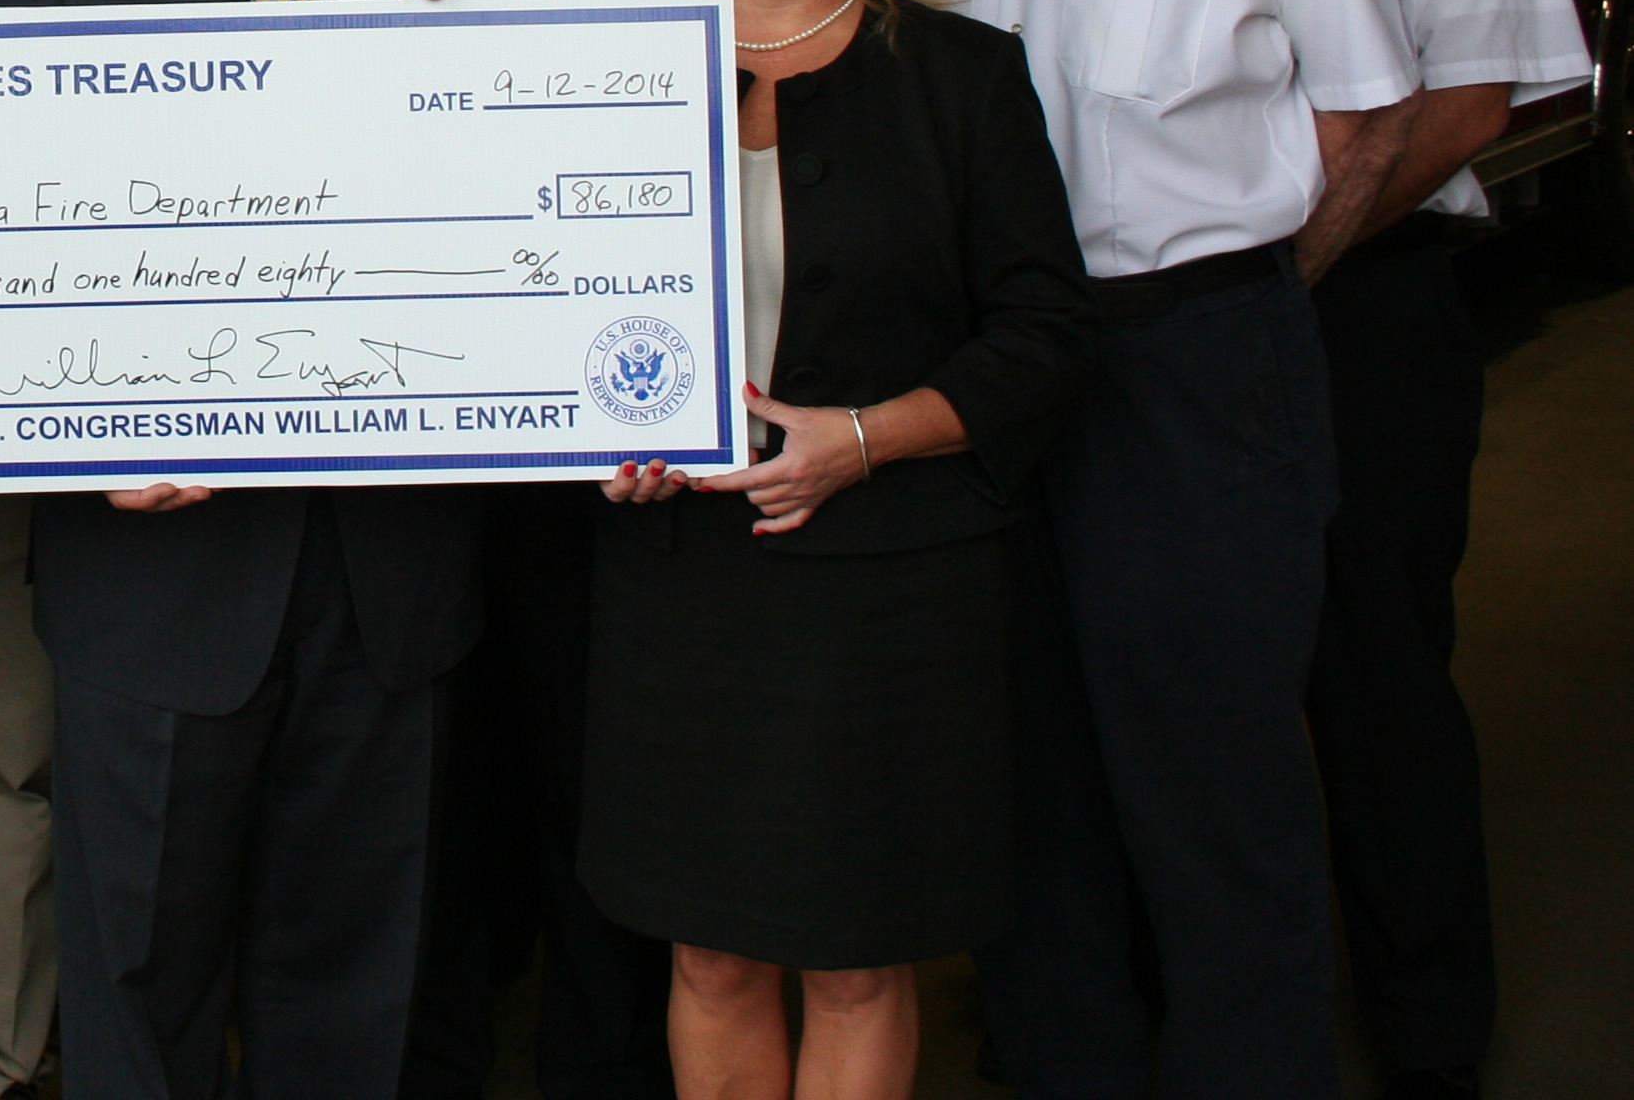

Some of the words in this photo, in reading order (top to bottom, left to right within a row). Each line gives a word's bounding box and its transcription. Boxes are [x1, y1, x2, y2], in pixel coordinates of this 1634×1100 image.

[45, 59, 274, 96] TREASURY
[493, 69, 675, 104] 9-12-2014
[409, 91, 474, 112] DATE
[35, 182, 108, 223] Fire
[128, 178, 339, 224] Department
[570, 180, 674, 216] 86,180
[73, 273, 122, 290] one
[132, 250, 247, 289] hundred
[257, 249, 346, 298] eighty
[574, 273, 694, 296] DOLLARS
[595, 331, 619, 352] U.S.
[620, 319, 671, 340] HOUSE
[669, 335, 688, 355] OF
[589, 371, 692, 422] REPRESENTATIVES
[16, 411, 265, 441] CONGRESSMAN
[274, 407, 408, 436] WILLIAM
[419, 407, 445, 432] L.
[455, 404, 581, 431] ENYART
